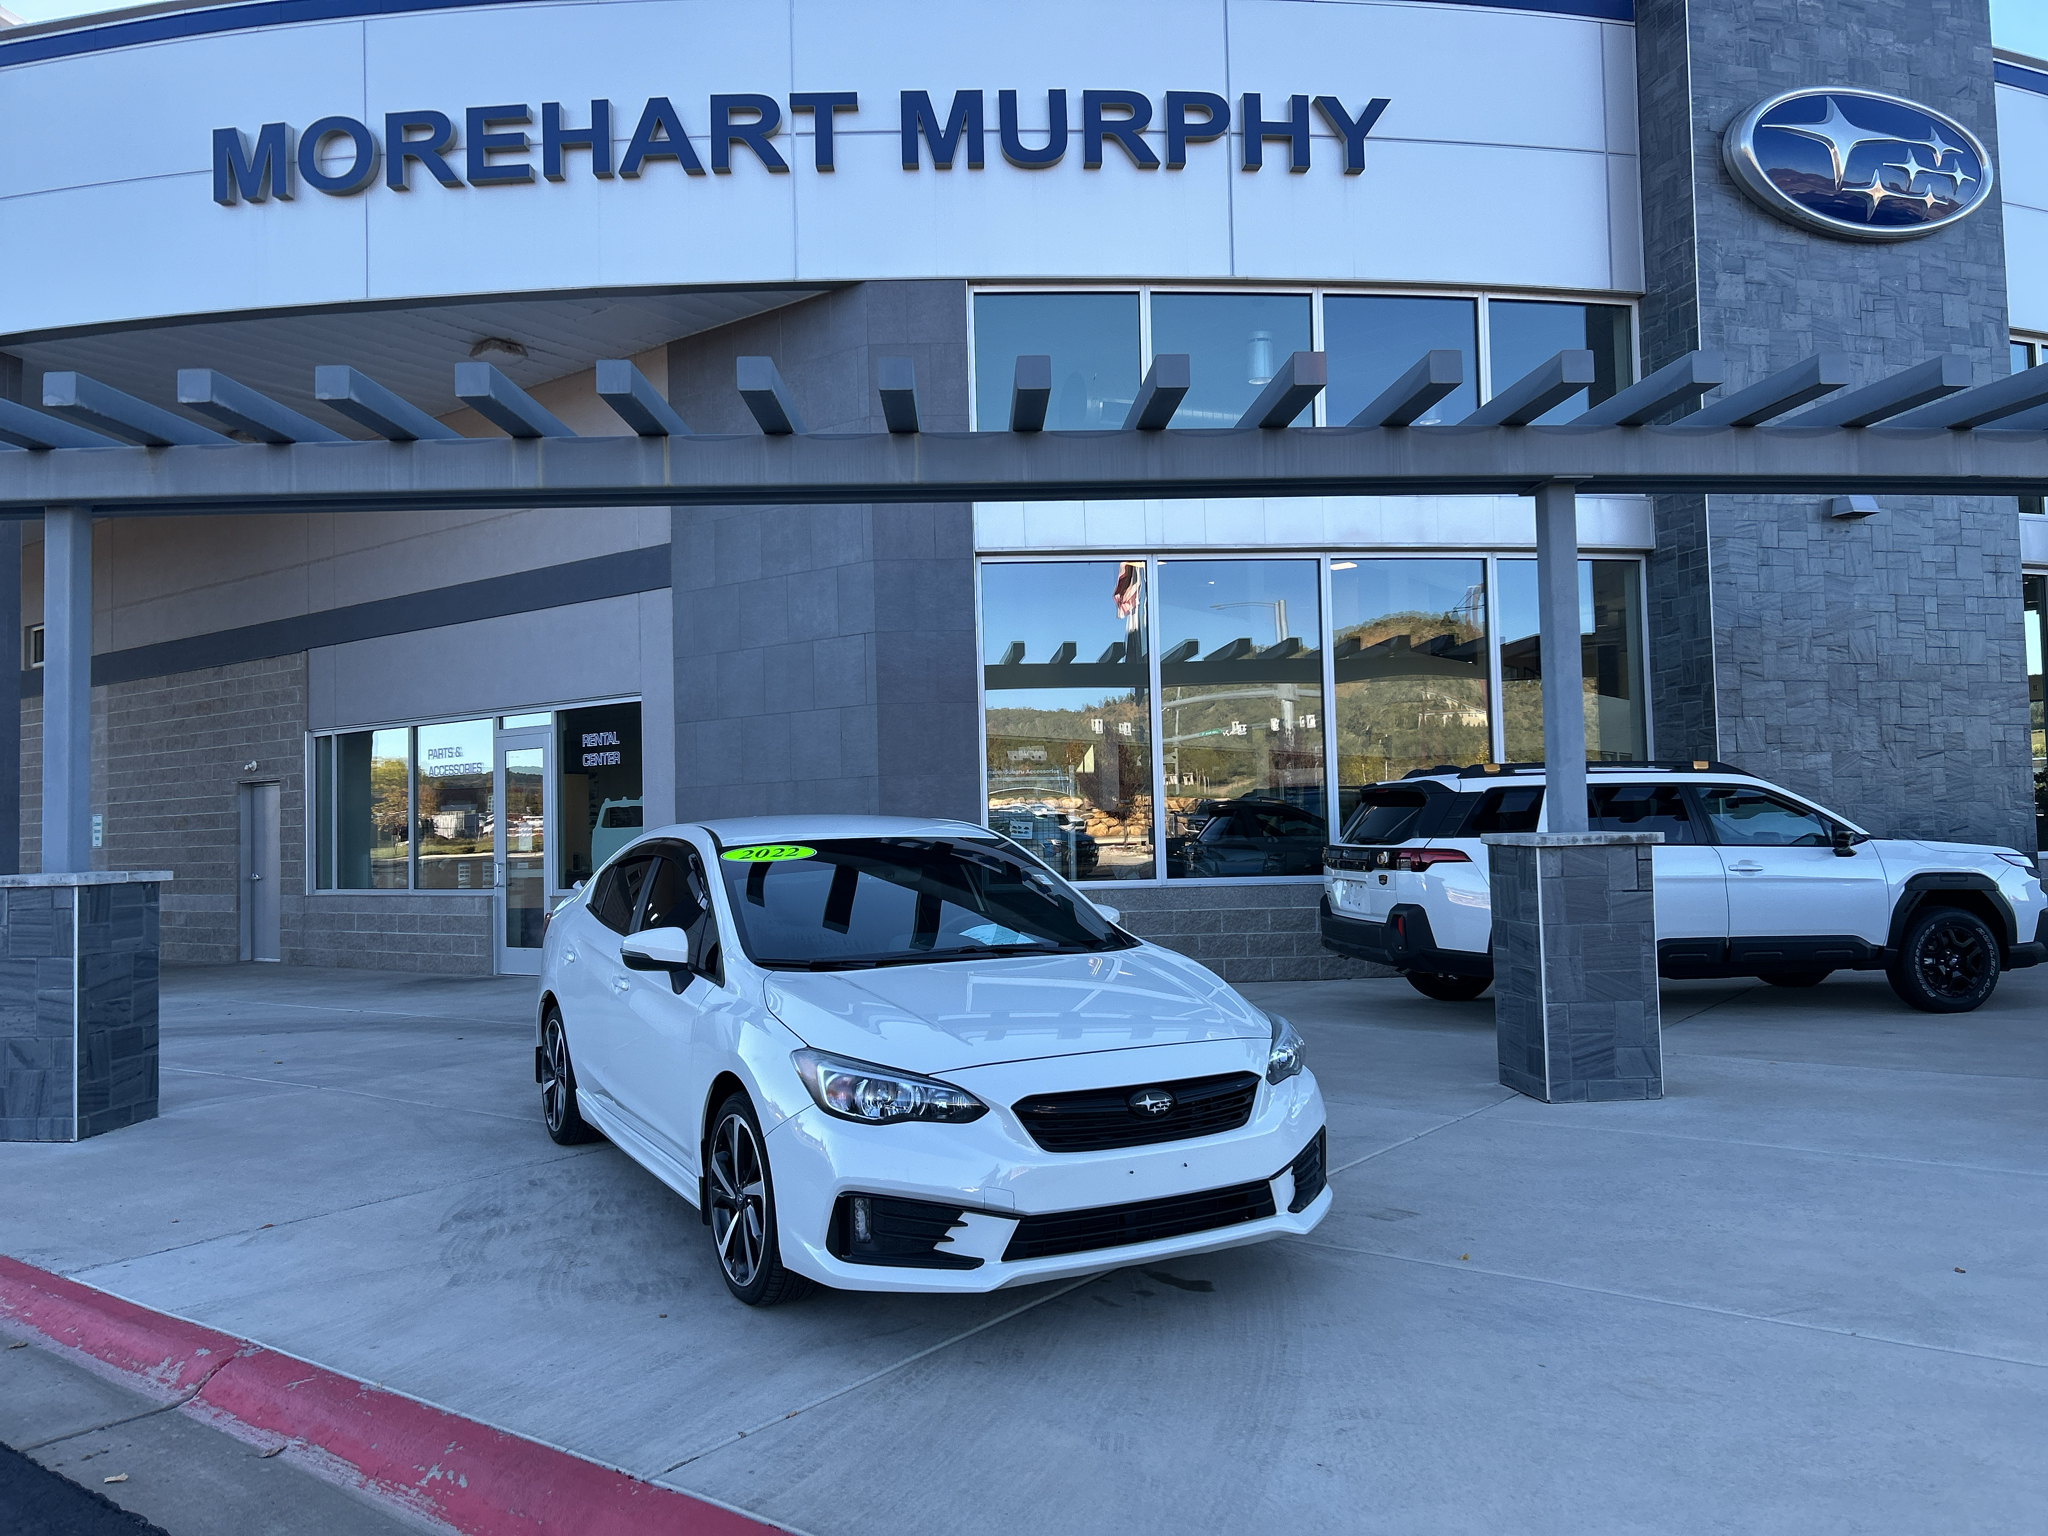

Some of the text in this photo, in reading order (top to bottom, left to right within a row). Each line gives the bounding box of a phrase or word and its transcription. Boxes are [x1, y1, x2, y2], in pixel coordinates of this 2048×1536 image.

[212, 88, 1392, 205] MOREHART MURPHY
[582, 731, 620, 747] RENTAL
[427, 746, 464, 760] PARTS &
[582, 751, 621, 766] CENTER
[428, 762, 483, 777] ACCESSORIES
[738, 847, 800, 860] 2022
